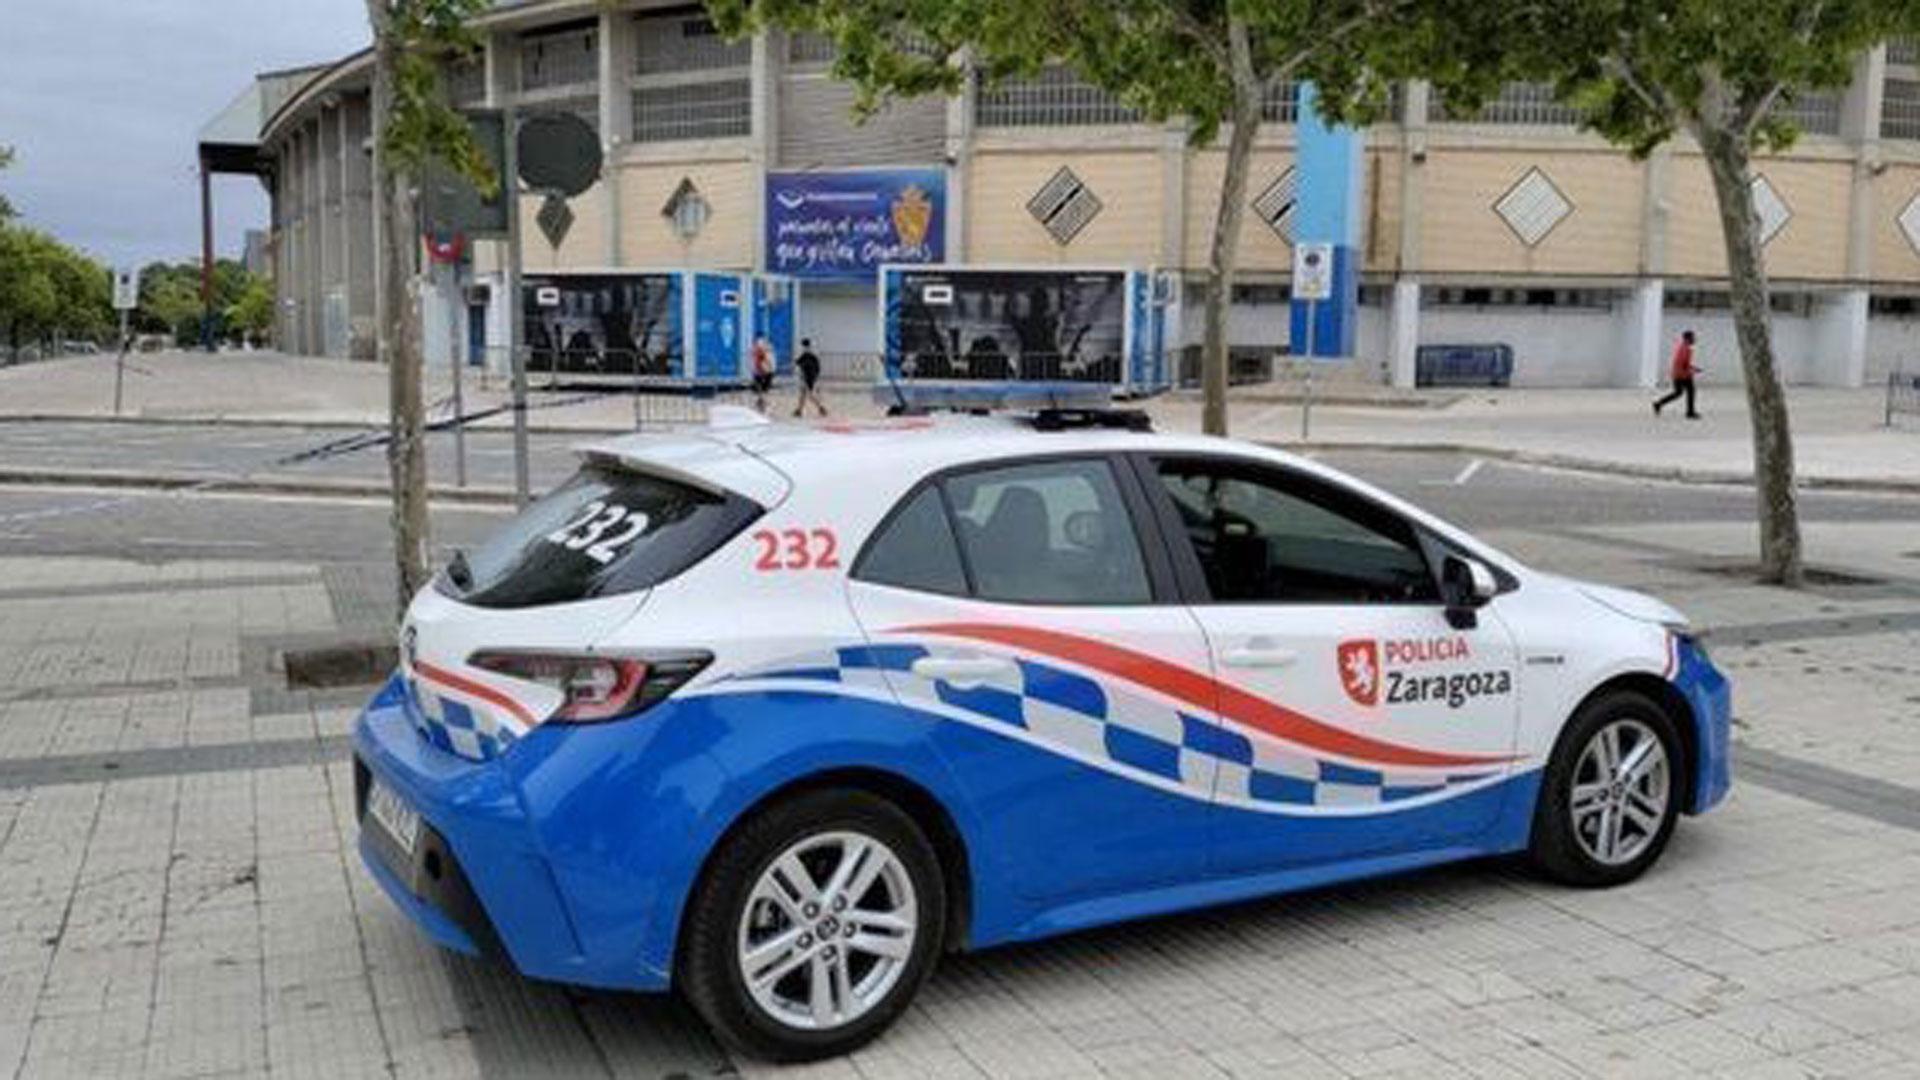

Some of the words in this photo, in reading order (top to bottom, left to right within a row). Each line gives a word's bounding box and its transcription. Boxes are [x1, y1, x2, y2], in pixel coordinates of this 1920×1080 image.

[549, 501, 649, 564] 232
[753, 528, 840, 571] 232
[1385, 638, 1470, 663] POLICIA
[1387, 670, 1511, 708] Zaragoza
